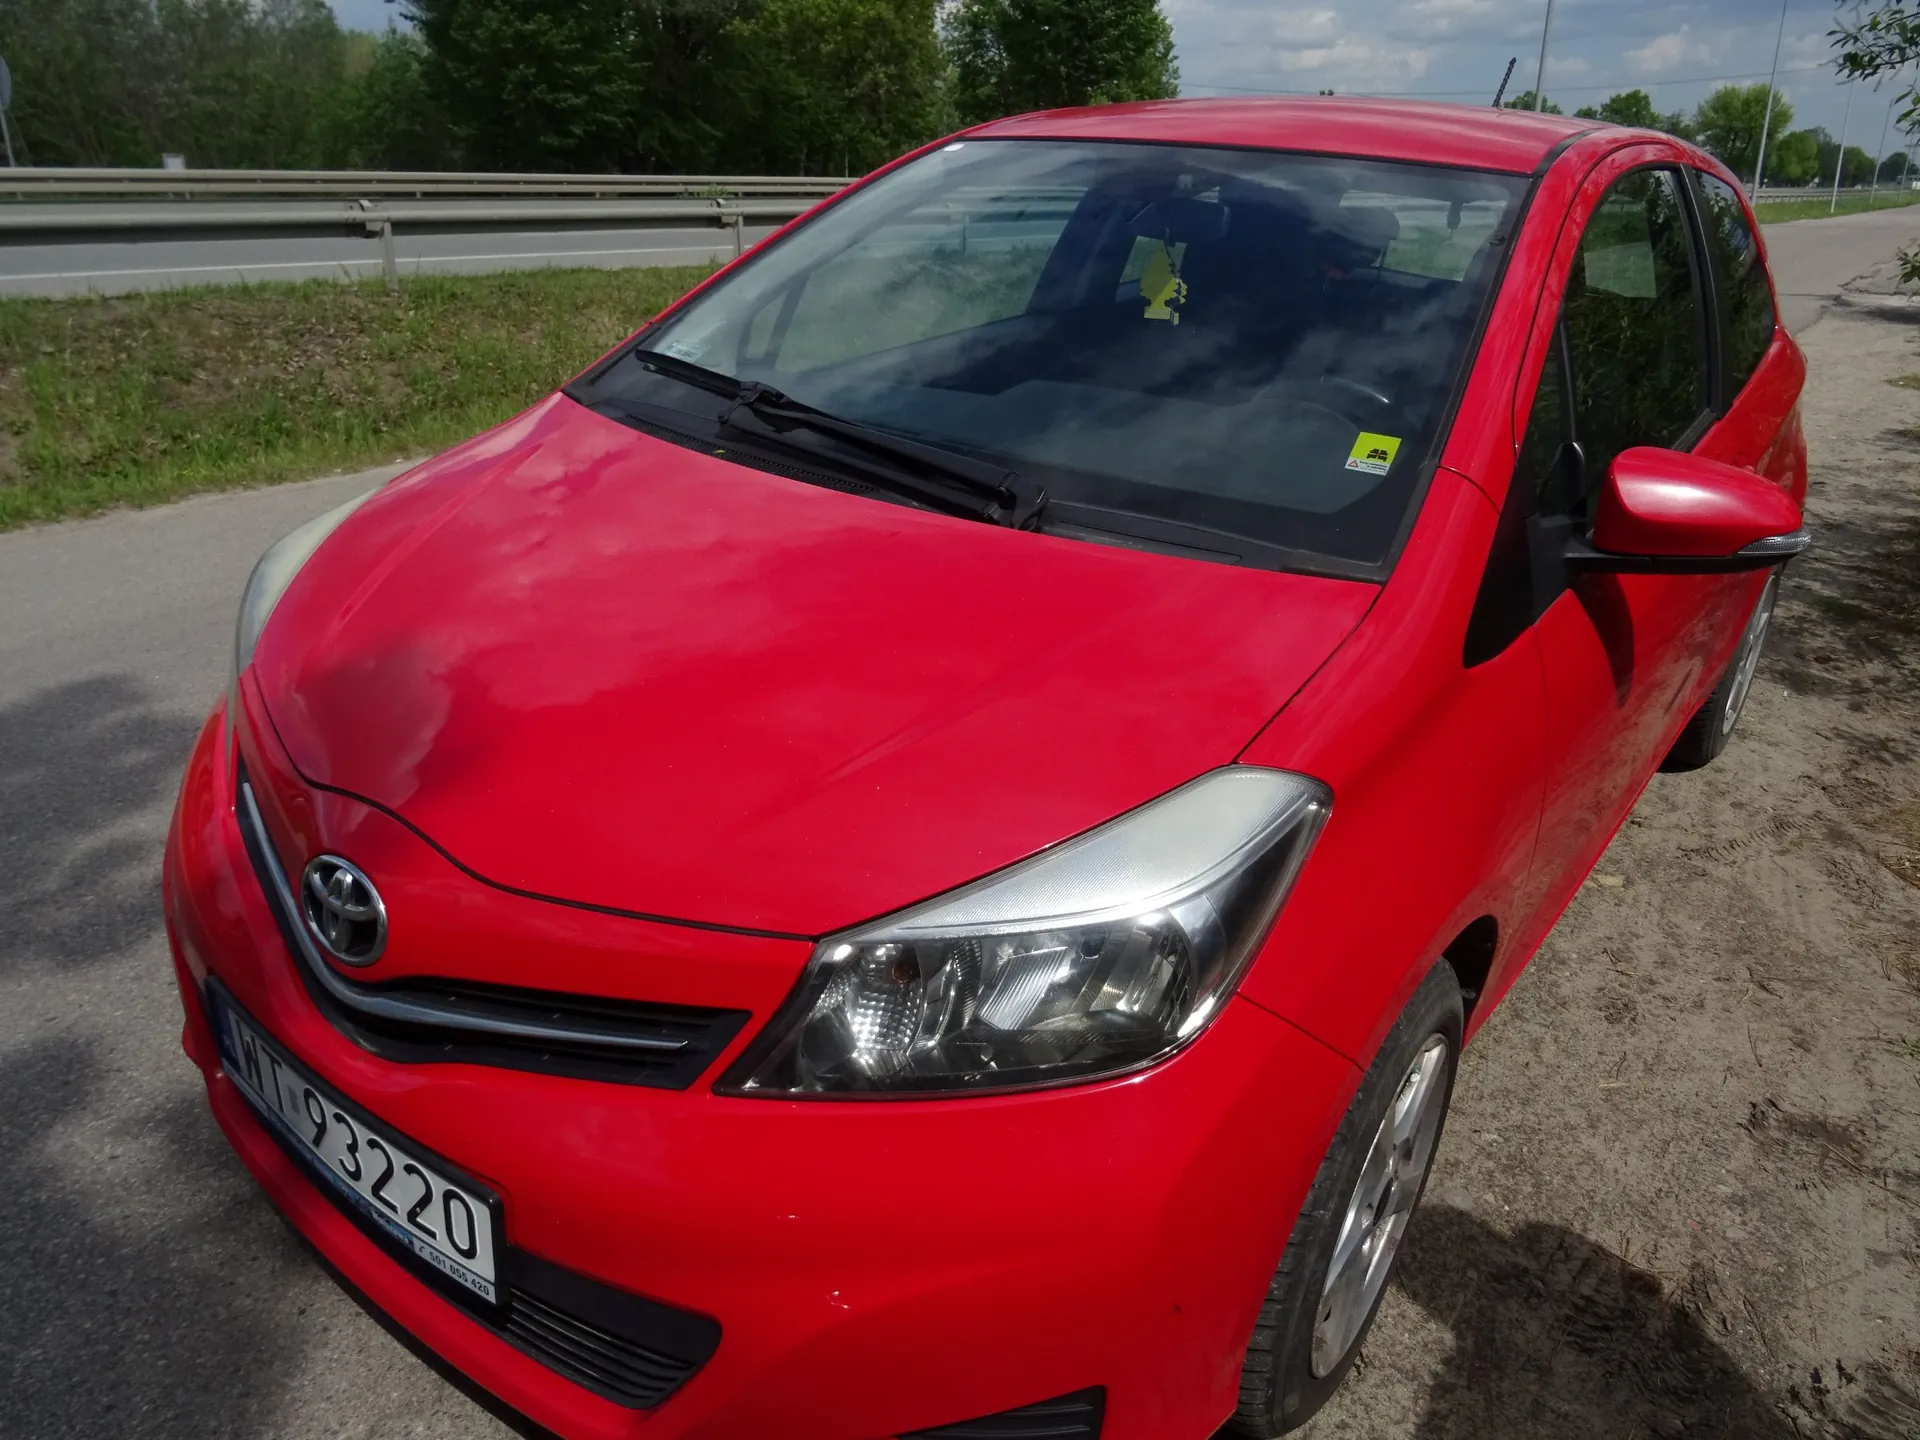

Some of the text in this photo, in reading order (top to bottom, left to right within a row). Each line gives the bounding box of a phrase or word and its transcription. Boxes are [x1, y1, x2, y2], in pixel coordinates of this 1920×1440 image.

[235, 1016, 479, 1260] WT 93220
[429, 1251, 490, 1296] 501 055 420
